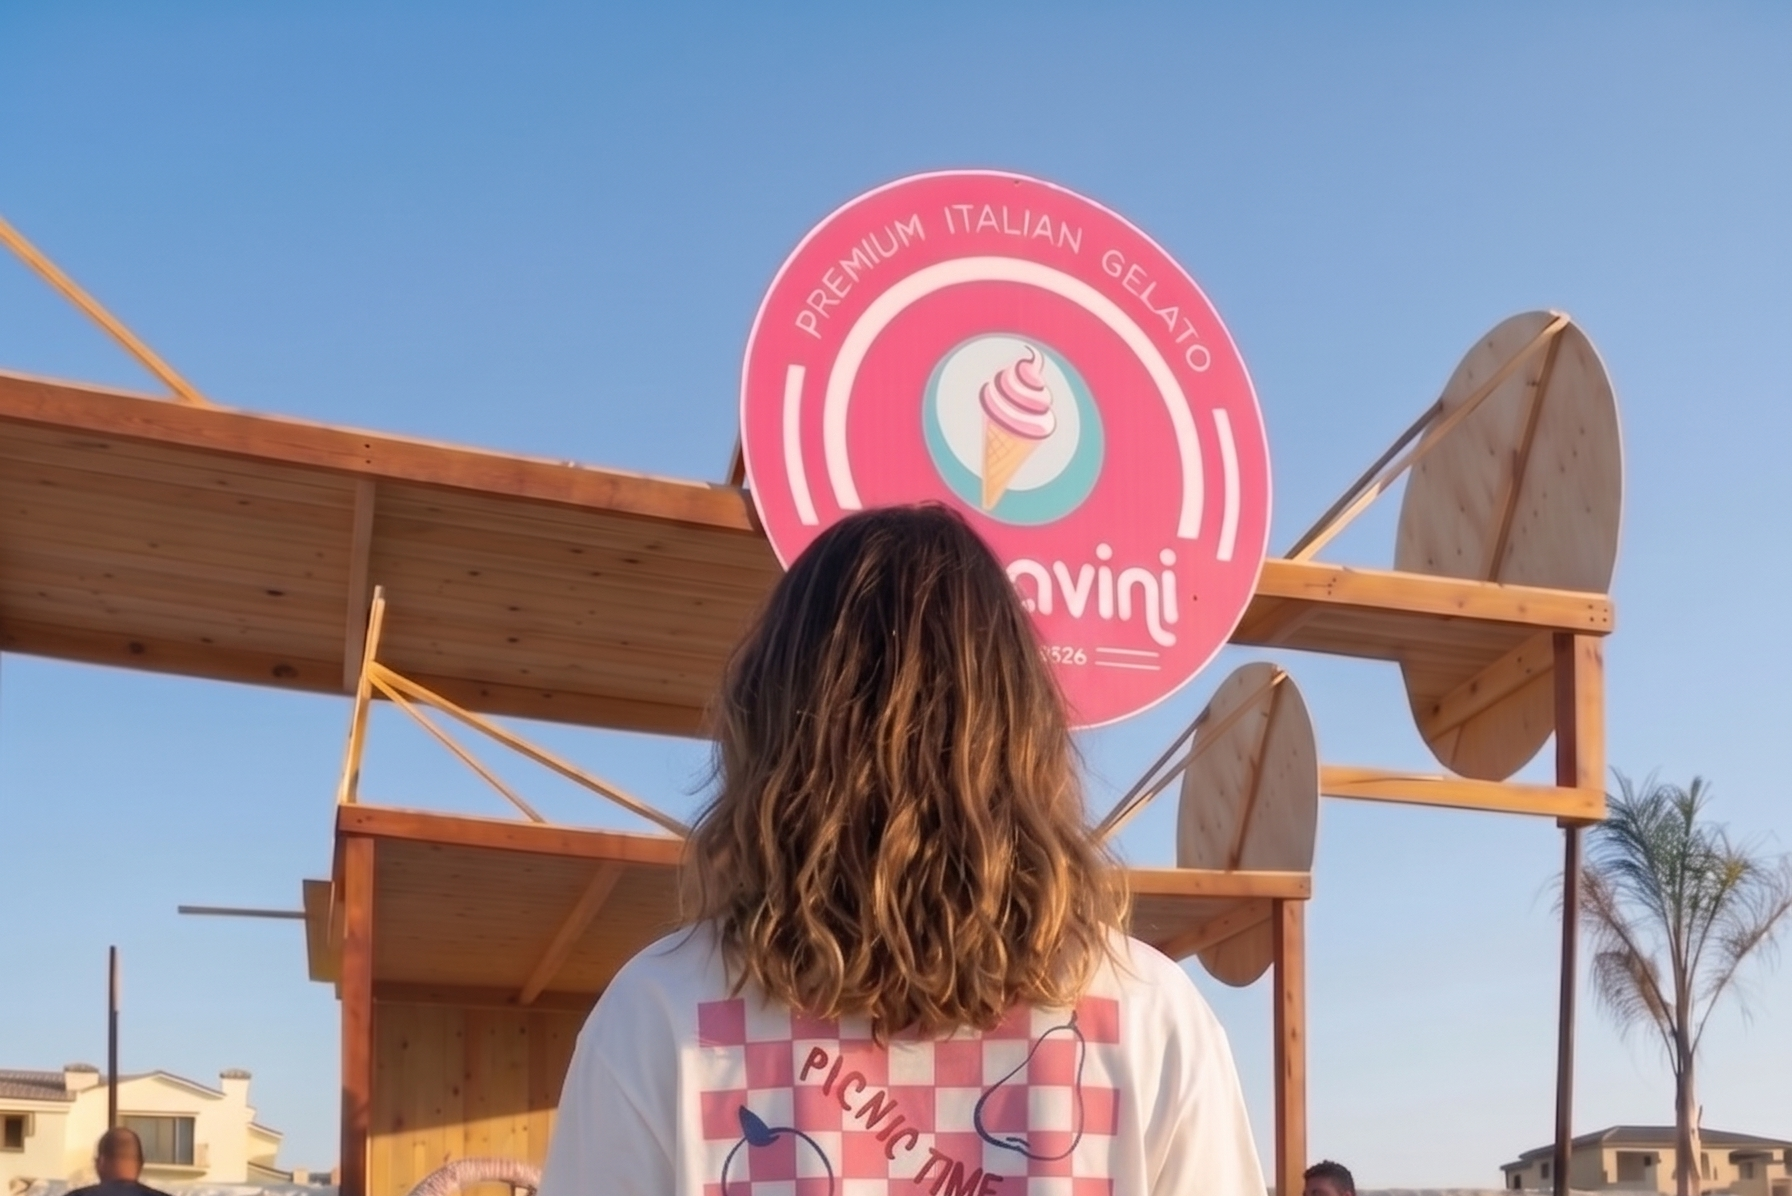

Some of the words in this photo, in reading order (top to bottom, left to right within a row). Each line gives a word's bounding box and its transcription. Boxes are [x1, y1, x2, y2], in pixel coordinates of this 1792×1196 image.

[794, 212, 926, 340] PREMIUM
[943, 203, 1083, 254] ITALIAN
[1101, 249, 1212, 373] GELATO
[799, 1046, 919, 1161] PICNIC
